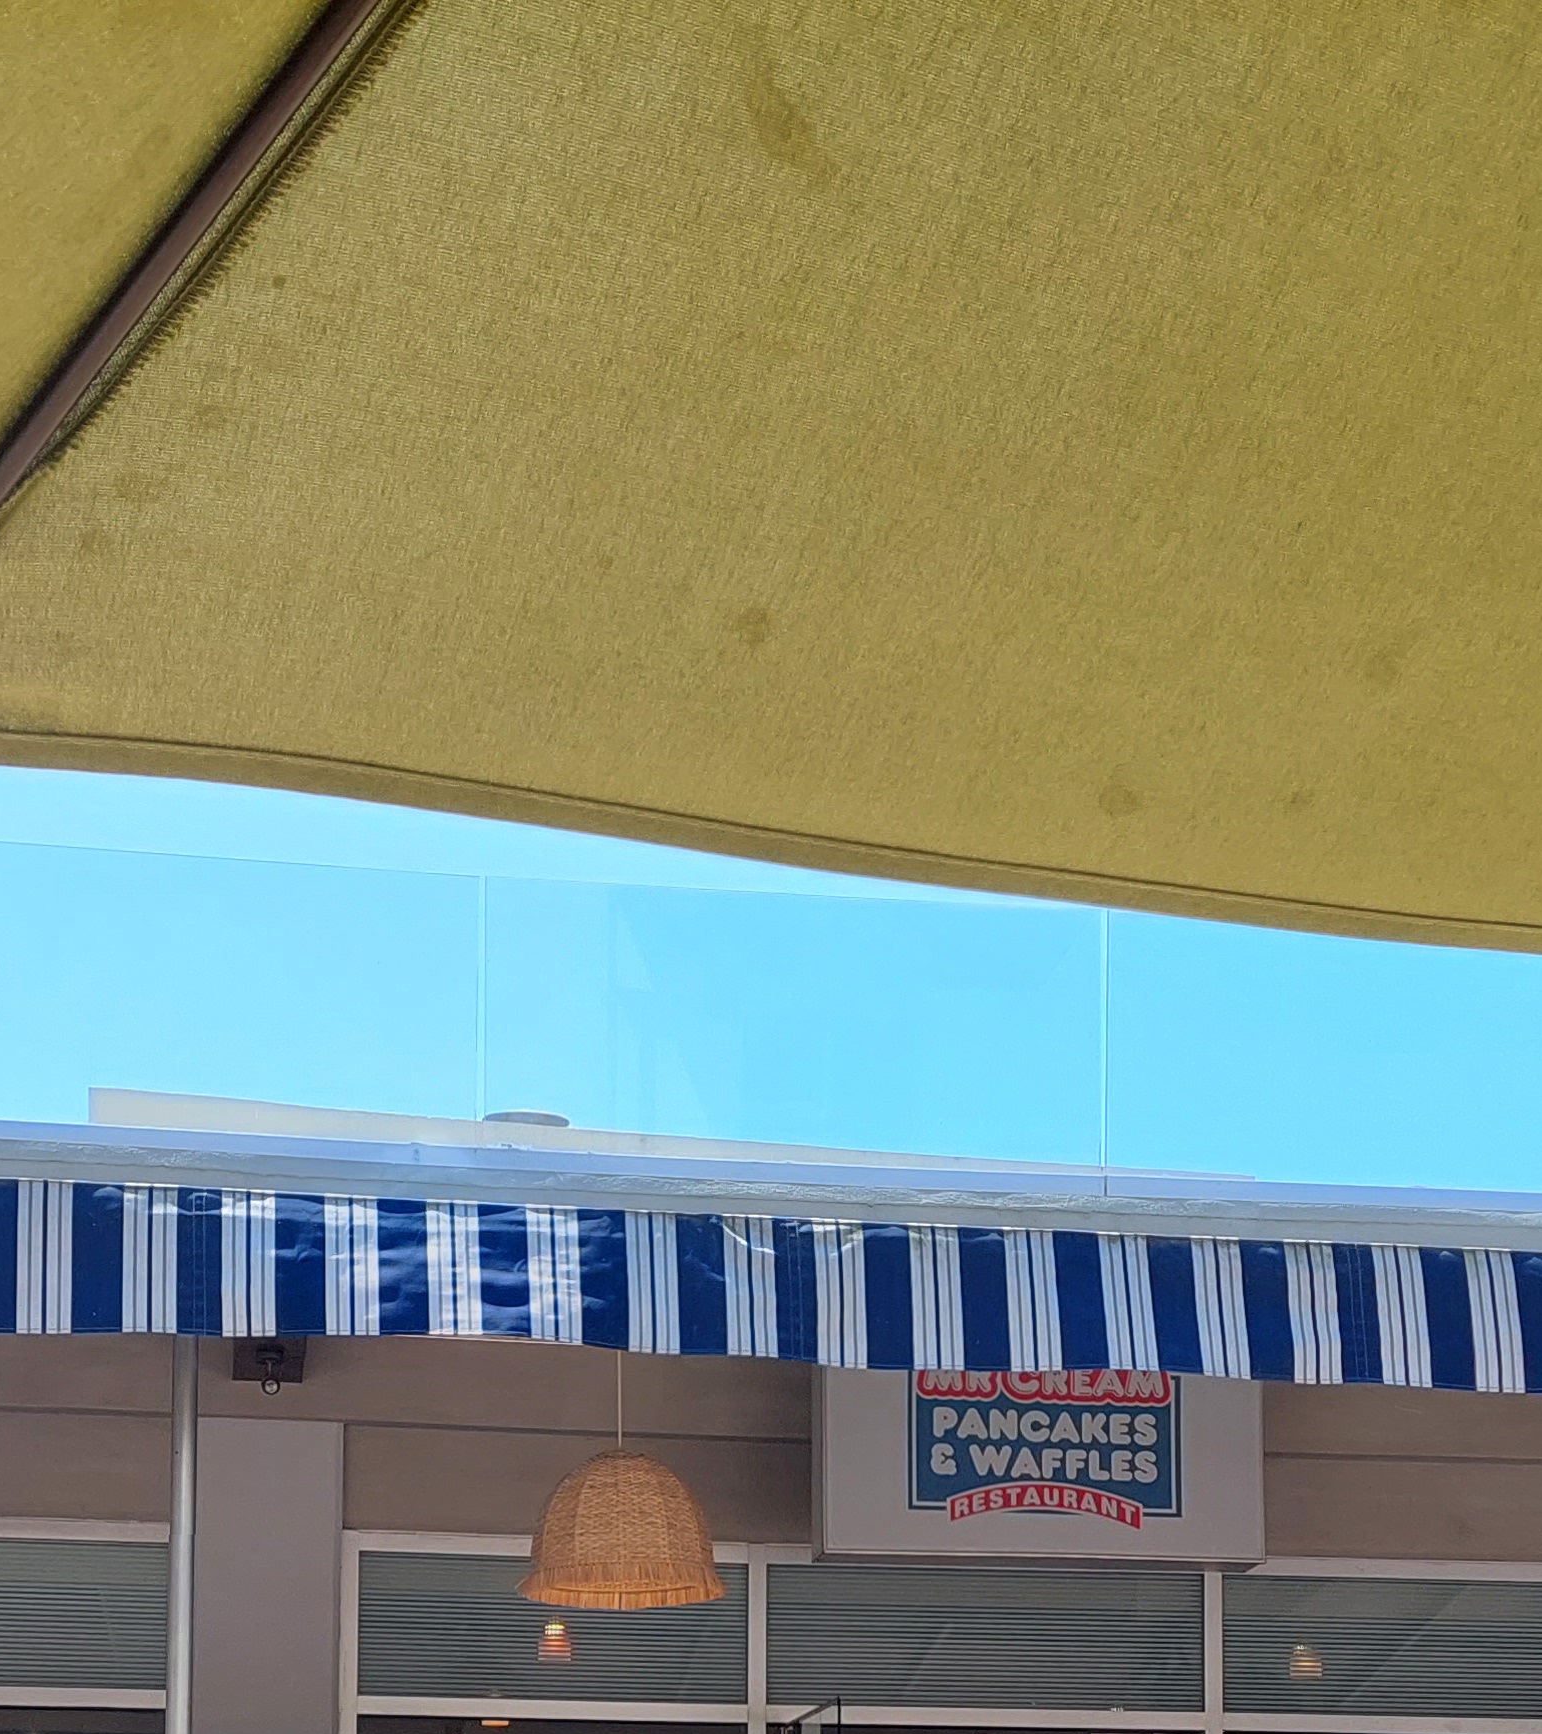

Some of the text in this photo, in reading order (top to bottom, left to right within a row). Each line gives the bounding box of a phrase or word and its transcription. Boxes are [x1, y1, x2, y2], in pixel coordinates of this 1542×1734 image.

[922, 1371, 1165, 1397] MR CREAM
[932, 1405, 1158, 1447] PANCAKES
[930, 1442, 1158, 1484] & WAFFLES
[954, 1486, 1139, 1525] RESTAURANT
